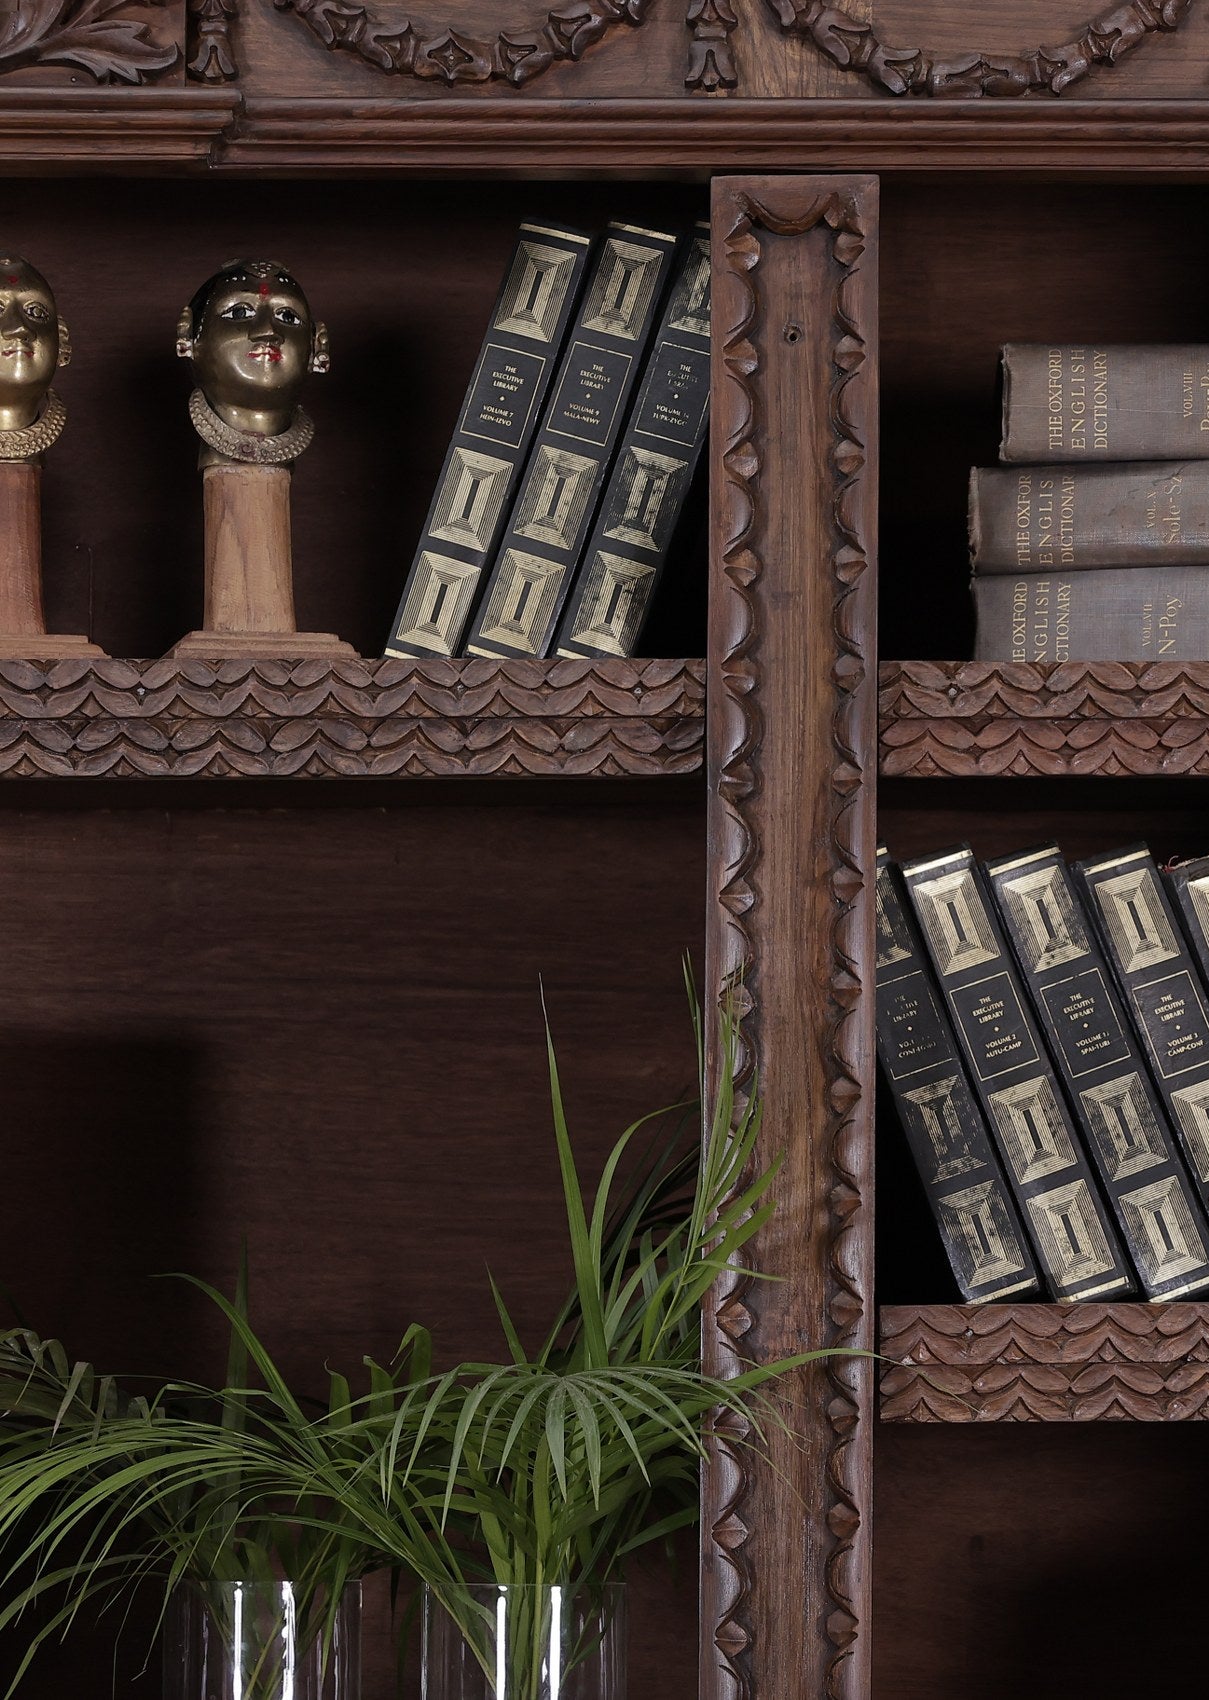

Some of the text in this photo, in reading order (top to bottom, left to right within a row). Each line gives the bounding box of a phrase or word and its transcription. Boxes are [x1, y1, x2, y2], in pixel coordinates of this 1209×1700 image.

[505, 365, 518, 374] THE
[592, 364, 604, 372] THE
[680, 364, 692, 372] THE
[492, 372, 525, 384] EXECUTIVE
[580, 370, 611, 383] EXECUTIVE
[493, 380, 518, 392] LIBRARY
[580, 379, 604, 390] LIBRARY
[1048, 349, 1063, 450] THE OXFORD
[1071, 349, 1086, 450] ENGLISH
[1093, 350, 1108, 449] DICTIONARY
[483, 405, 509, 416] VOLUME
[569, 403, 594, 415] VOLUME
[1017, 473, 1032, 565] THE OXFOR
[1039, 480, 1054, 564] ENGLIS
[1061, 474, 1075, 563] DICTIONAR
[1012, 582, 1028, 645] OXFORD
[1034, 581, 1050, 662] NGLISH
[1056, 582, 1072, 663] CTIONARY
[1159, 594, 1183, 654] N-Poy
[979, 996, 991, 1004] THE
[1069, 993, 1082, 1002] THE
[1160, 994, 1173, 1002] THE
[972, 1000, 1005, 1017] EXECUTIVE
[1063, 997, 1095, 1014] EXECUTIVE
[1154, 999, 1185, 1015] EXECUTIVE
[978, 1010, 1004, 1024] LIBRARY
[1069, 1007, 1095, 1021] LIBRARY
[1160, 1009, 1185, 1022] LIBRARY
[985, 1035, 1011, 1049] VOLUME
[1076, 1033, 1101, 1048] VOLUME
[1167, 1034, 1193, 1047] VOLUME
